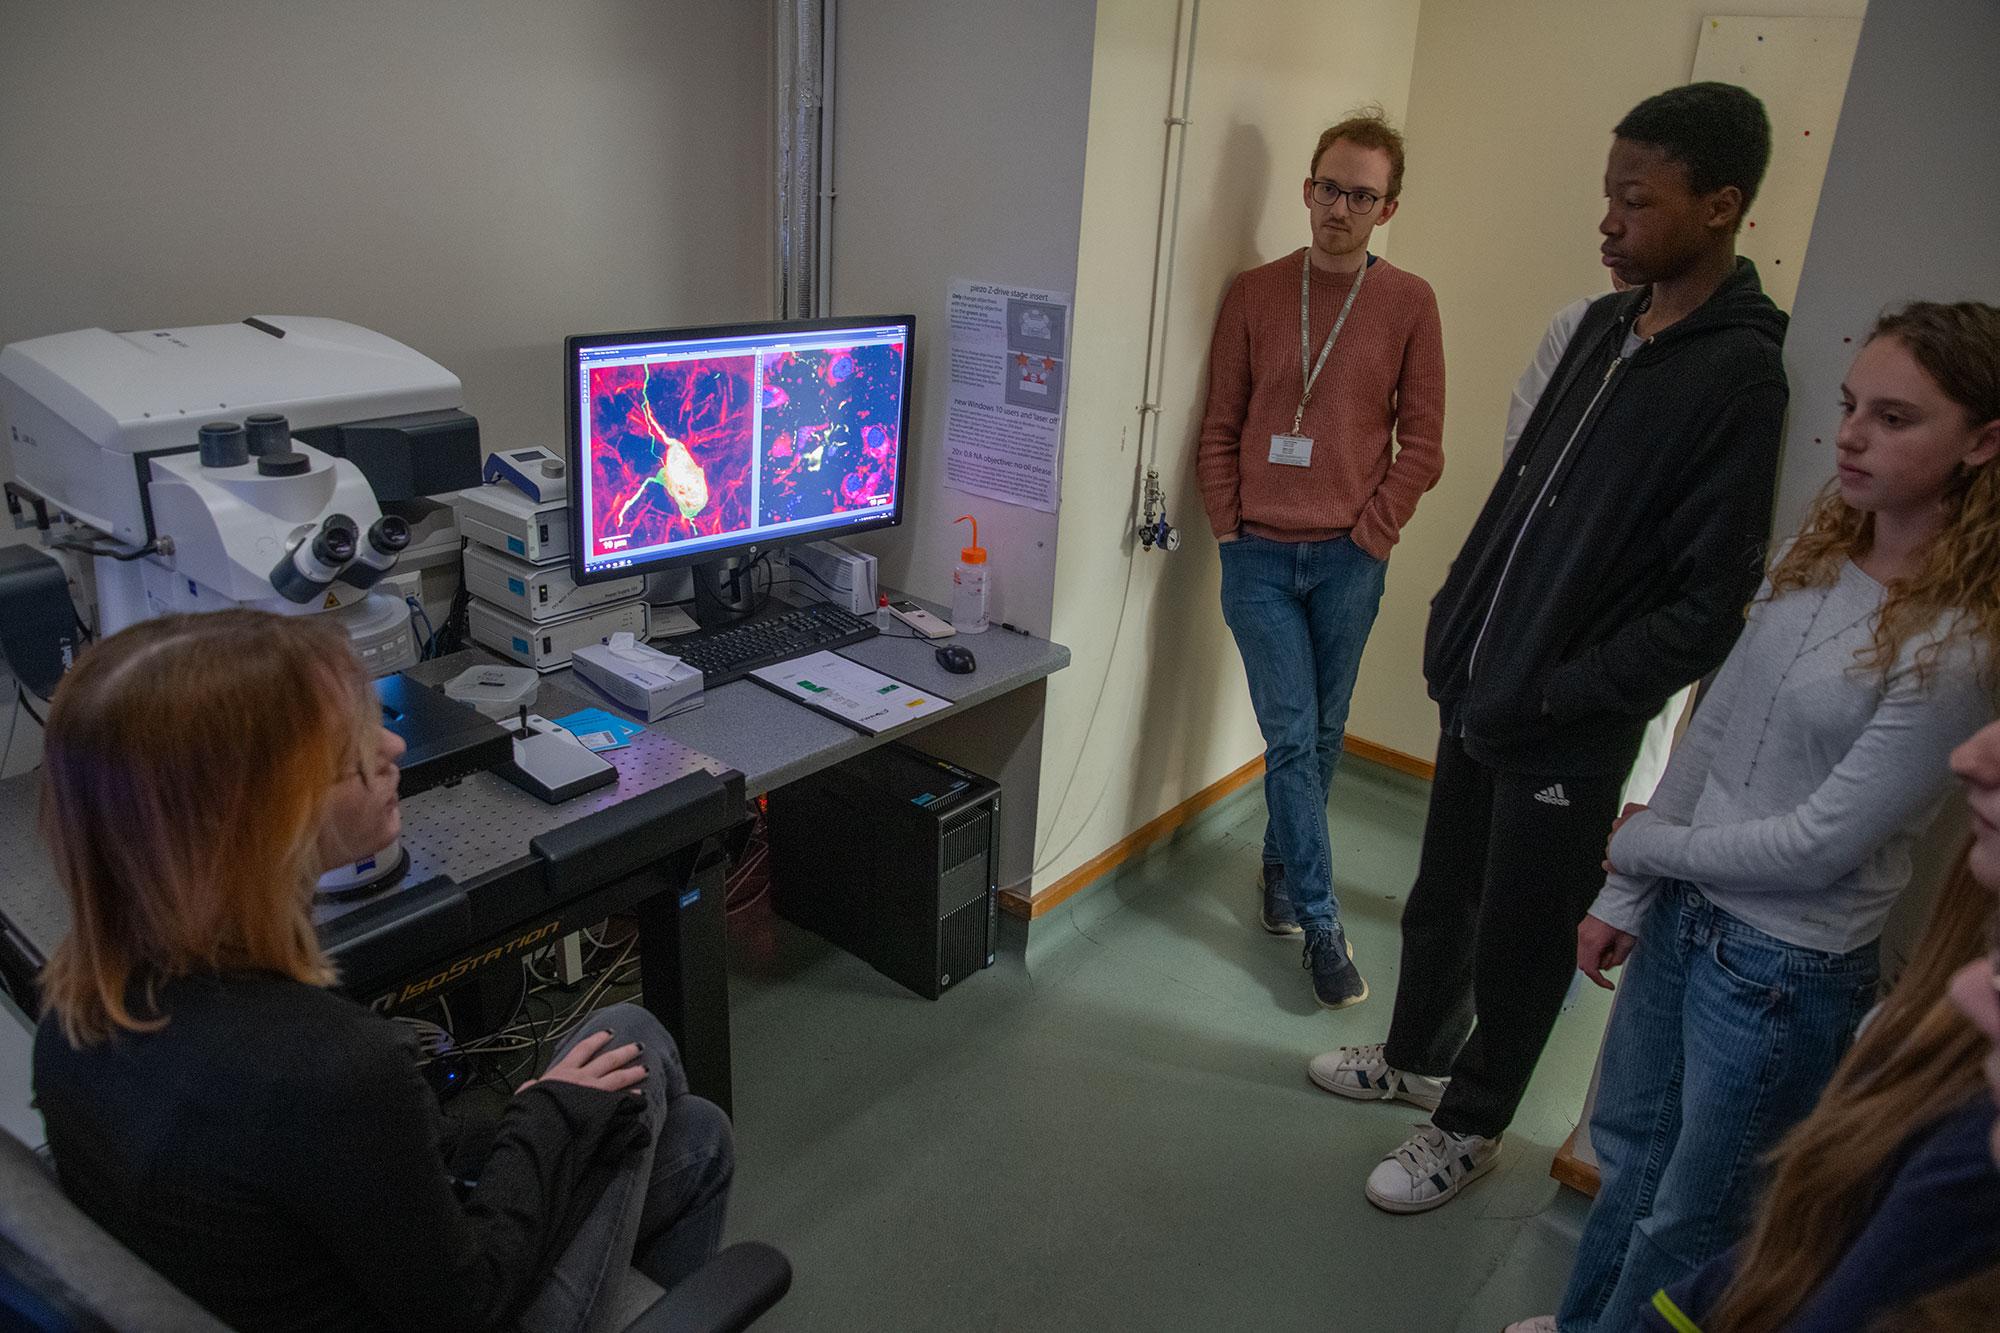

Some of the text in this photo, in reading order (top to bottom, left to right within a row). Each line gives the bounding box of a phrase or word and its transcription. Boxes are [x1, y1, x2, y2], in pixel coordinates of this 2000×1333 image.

[1011, 289, 1028, 300] stage
[1029, 291, 1048, 301] insert
[1335, 317, 1345, 332] STAFF
[1323, 341, 1333, 357] STAFF
[996, 405, 1003, 414] 10
[1004, 409, 1019, 418] users
[1020, 411, 1033, 420] and
[1534, 793, 1570, 807] adidas
